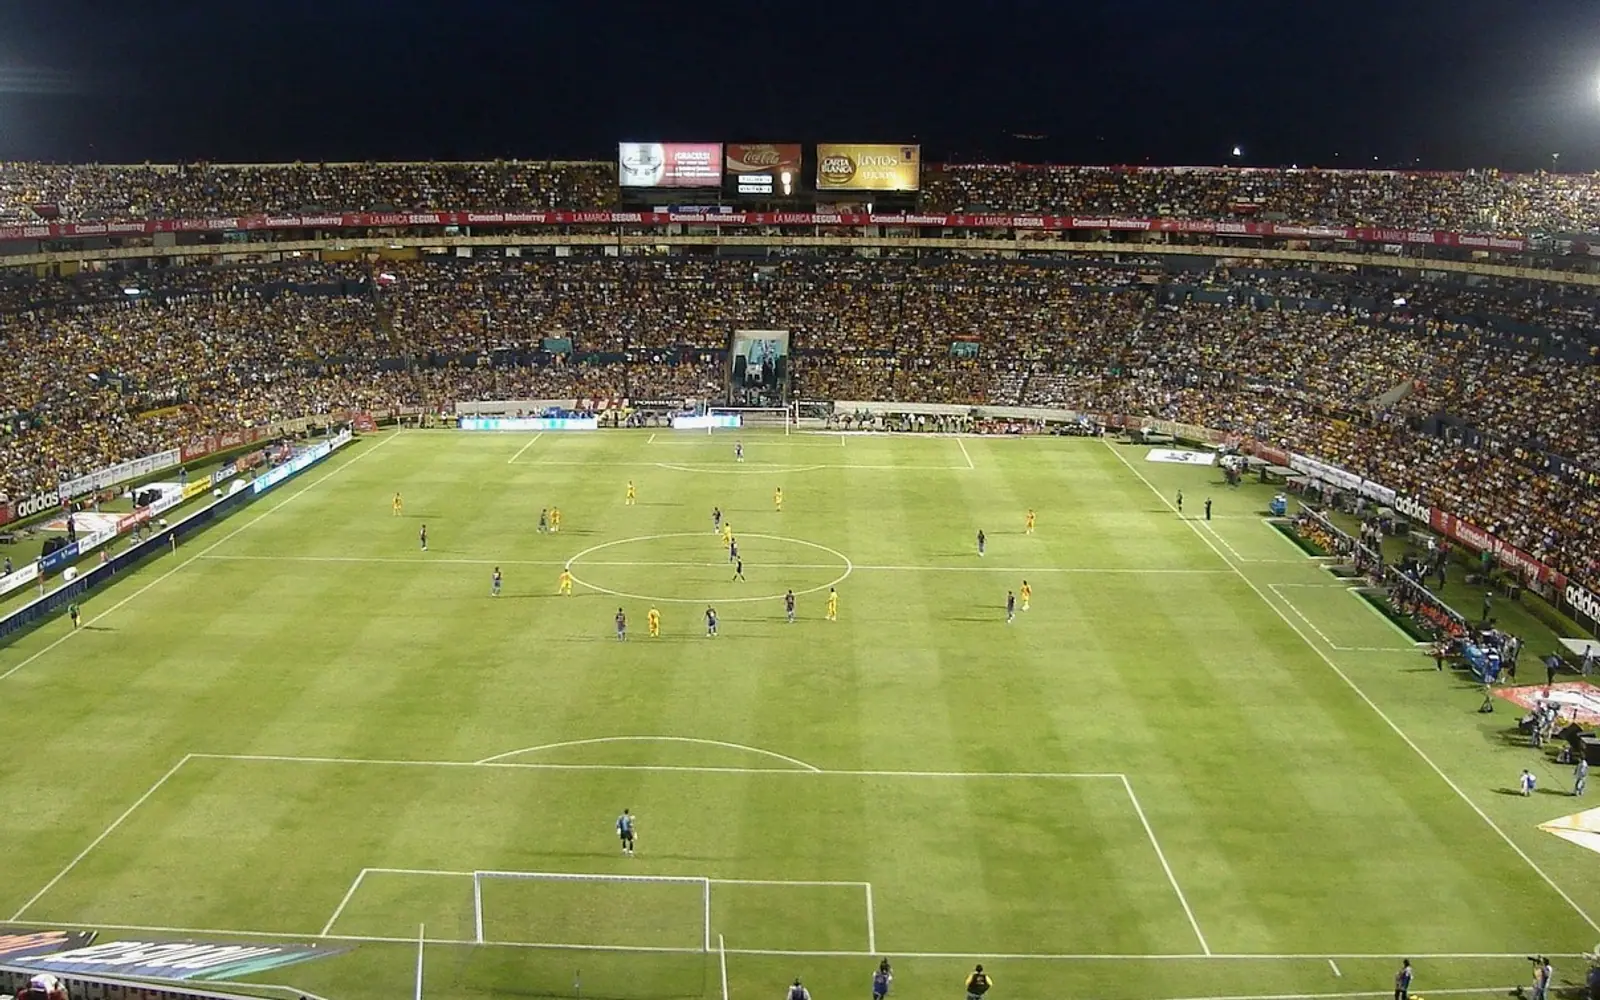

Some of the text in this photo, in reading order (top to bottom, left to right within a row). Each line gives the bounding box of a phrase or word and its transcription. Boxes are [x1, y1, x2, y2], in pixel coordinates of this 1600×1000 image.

[824, 157, 850, 166] CARTA
[821, 164, 853, 174] BLANCA
[266, 214, 343, 226] Cemento Monterrey
[370, 214, 440, 224] LA MARCA SEGURA
[468, 212, 546, 223] Cemento Monterrey
[572, 212, 642, 222] LA MARCA SEGURA
[670, 213, 746, 223] Cemento Monterrey
[773, 214, 842, 223] LA MARCA SEGURA
[870, 214, 947, 225] Cemento Monterrey
[974, 216, 1044, 226] LA MARCA SEGURA
[1073, 217, 1150, 229] Cemento Monterrey
[1372, 230, 1382, 240] LA
[18, 491, 59, 517] adidas
[1395, 493, 1431, 524] adidas
[1456, 519, 1493, 553] Cemento
